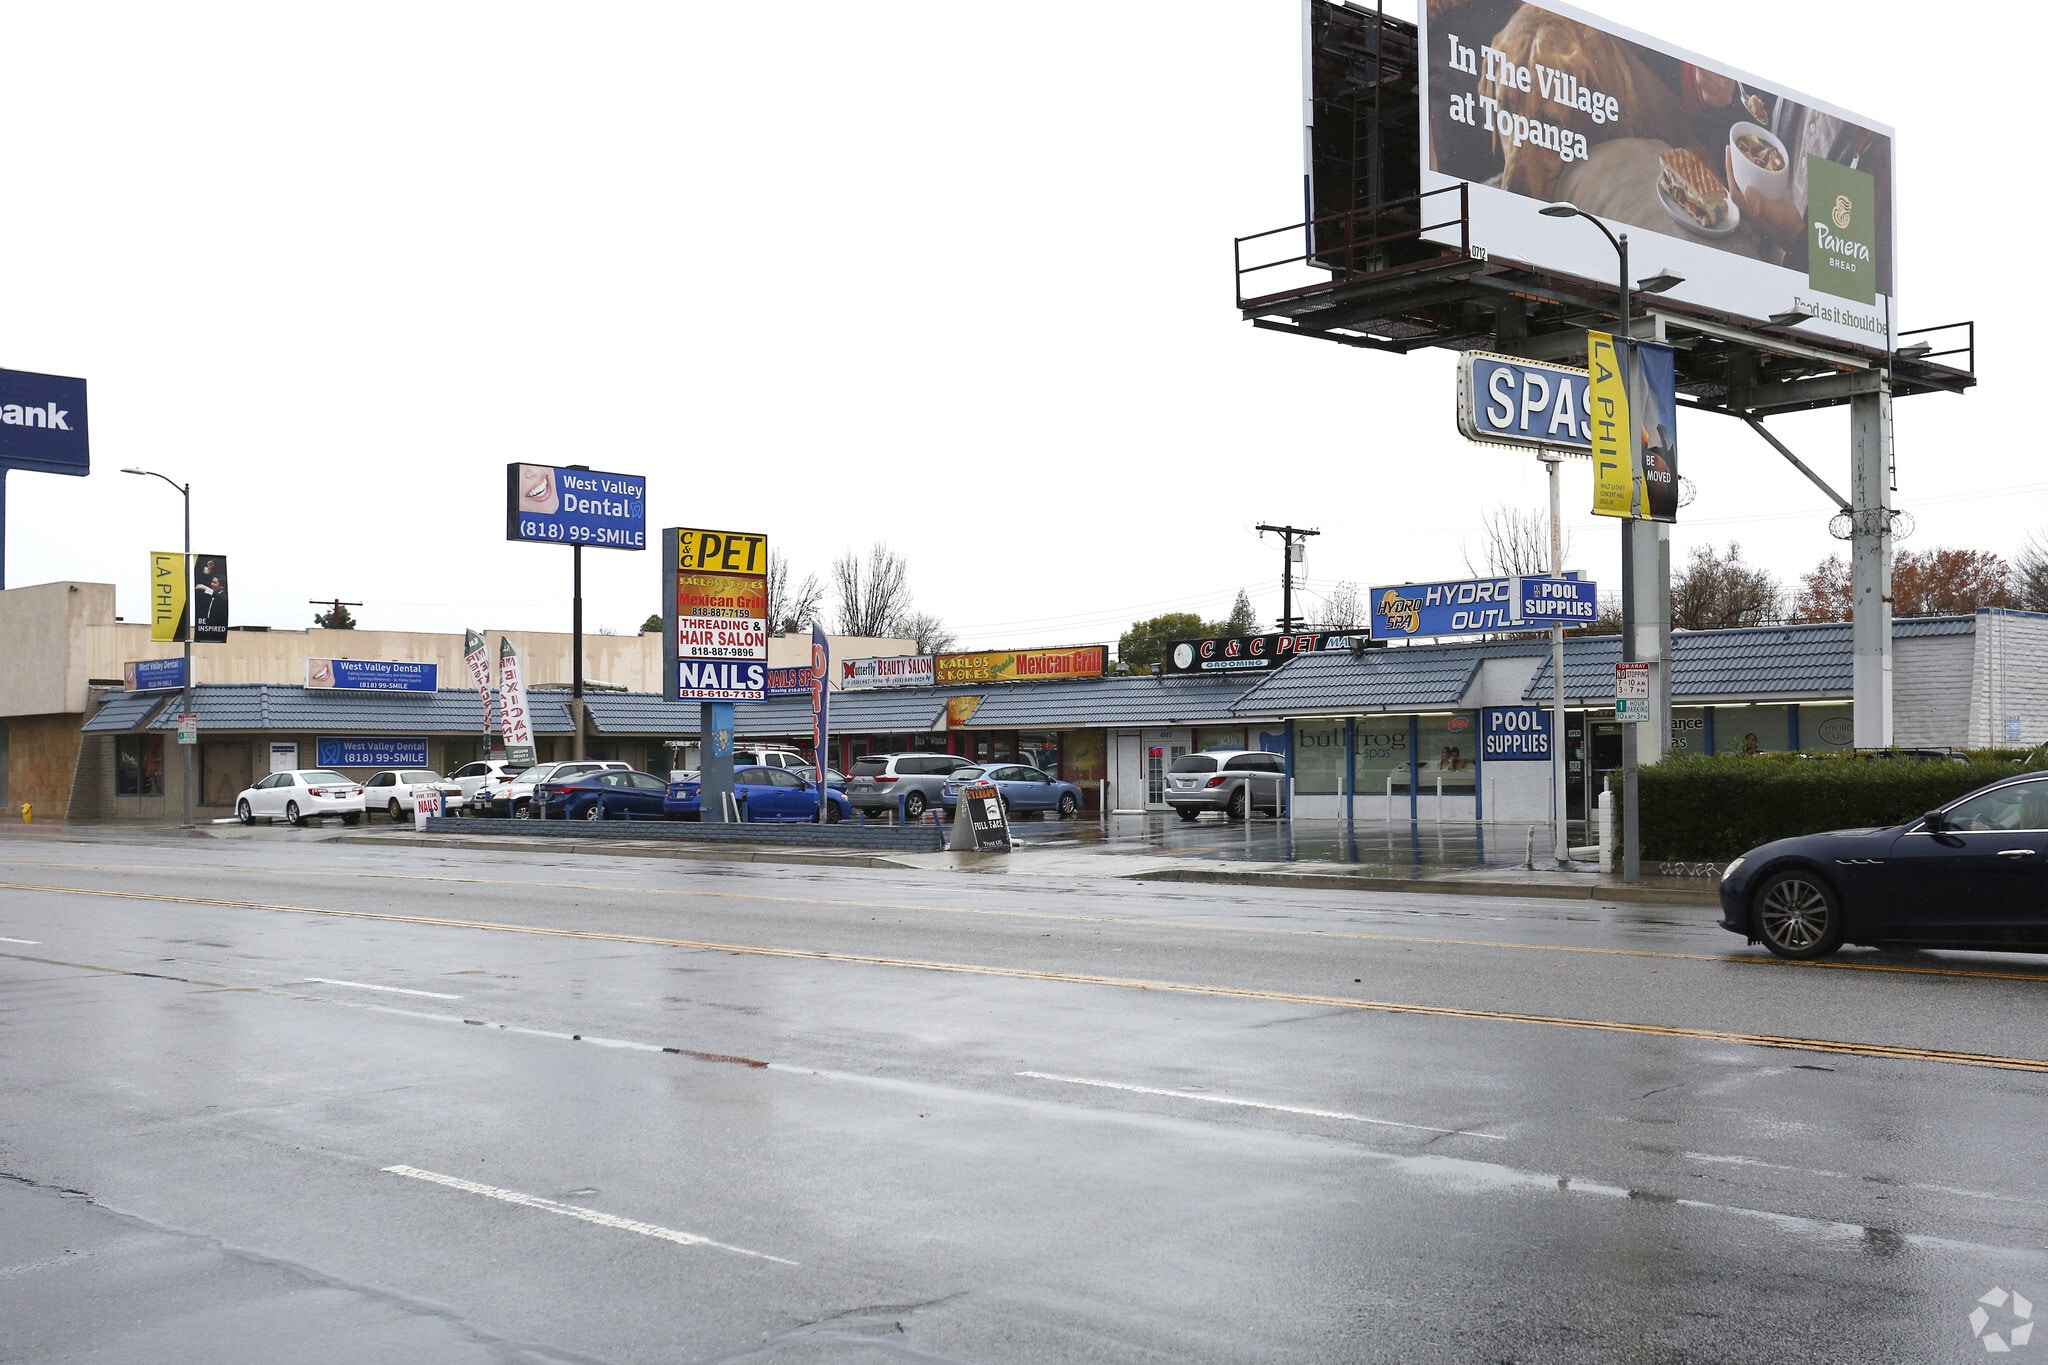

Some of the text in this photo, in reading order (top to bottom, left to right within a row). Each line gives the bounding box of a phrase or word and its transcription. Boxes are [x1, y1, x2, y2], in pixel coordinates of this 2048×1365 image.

[1448, 33, 1619, 124] In The Village
[1450, 92, 1589, 163] at Topanga
[1814, 221, 1870, 262] Panera
[1829, 257, 1857, 273] BREAD
[1821, 308, 1833, 323] as
[1833, 307, 1841, 324] it
[1842, 310, 1875, 333] should
[0, 402, 70, 431] ank
[1594, 340, 1618, 480] LA PHIL
[1646, 455, 1655, 466] BE
[1647, 470, 1671, 483] MOVED
[563, 475, 643, 499] West Valley
[564, 493, 630, 518] Dental
[520, 520, 644, 546] (818) 99-SMILE
[680, 532, 694, 568] C & C
[697, 533, 763, 571] PET
[155, 556, 172, 625] LA PHIL
[1425, 580, 1509, 607] HYDRO
[1541, 583, 1578, 600] POOL
[678, 592, 765, 609] Mexican Grill
[1377, 598, 1422, 615] HYDRO
[1525, 600, 1593, 617] SUPPLIES
[198, 617, 207, 625] BE
[692, 607, 750, 618] 818-887-7159
[1451, 608, 1535, 630] OUTL
[198, 625, 226, 633] INSPIRED
[682, 618, 761, 632] THREADING &
[1385, 615, 1412, 629] SPA
[680, 630, 764, 647] HAIR SALON
[1201, 640, 1214, 658] C
[1225, 639, 1240, 657] &
[1250, 637, 1264, 656] C
[1276, 634, 1321, 654] PET
[691, 647, 754, 657] 818-887-9896
[340, 662, 422, 674] West Valley Dental
[878, 659, 906, 676] BEAUTY
[908, 658, 932, 674] SALON
[939, 656, 990, 670] KARLOS
[1016, 651, 1101, 676] Mexican Grill
[1206, 659, 1264, 668] GROOMING
[679, 662, 764, 690] NAILS
[767, 668, 813, 688] NAILS SP
[937, 669, 991, 682] & KOKES
[1616, 670, 1626, 678] NO
[682, 689, 762, 699] 818-610-7133
[1618, 686, 1623, 694] 3
[1448, 719, 1469, 729] OPEN
[1491, 711, 1543, 731] POOL
[344, 742, 425, 752] West Valley Dental
[1486, 733, 1548, 753] SUPPLIES
[344, 753, 425, 764] (818) 99-SMILE
[1364, 749, 1391, 760] spas
[418, 799, 439, 813] NAILS
[974, 819, 1003, 831] FULL FACE
